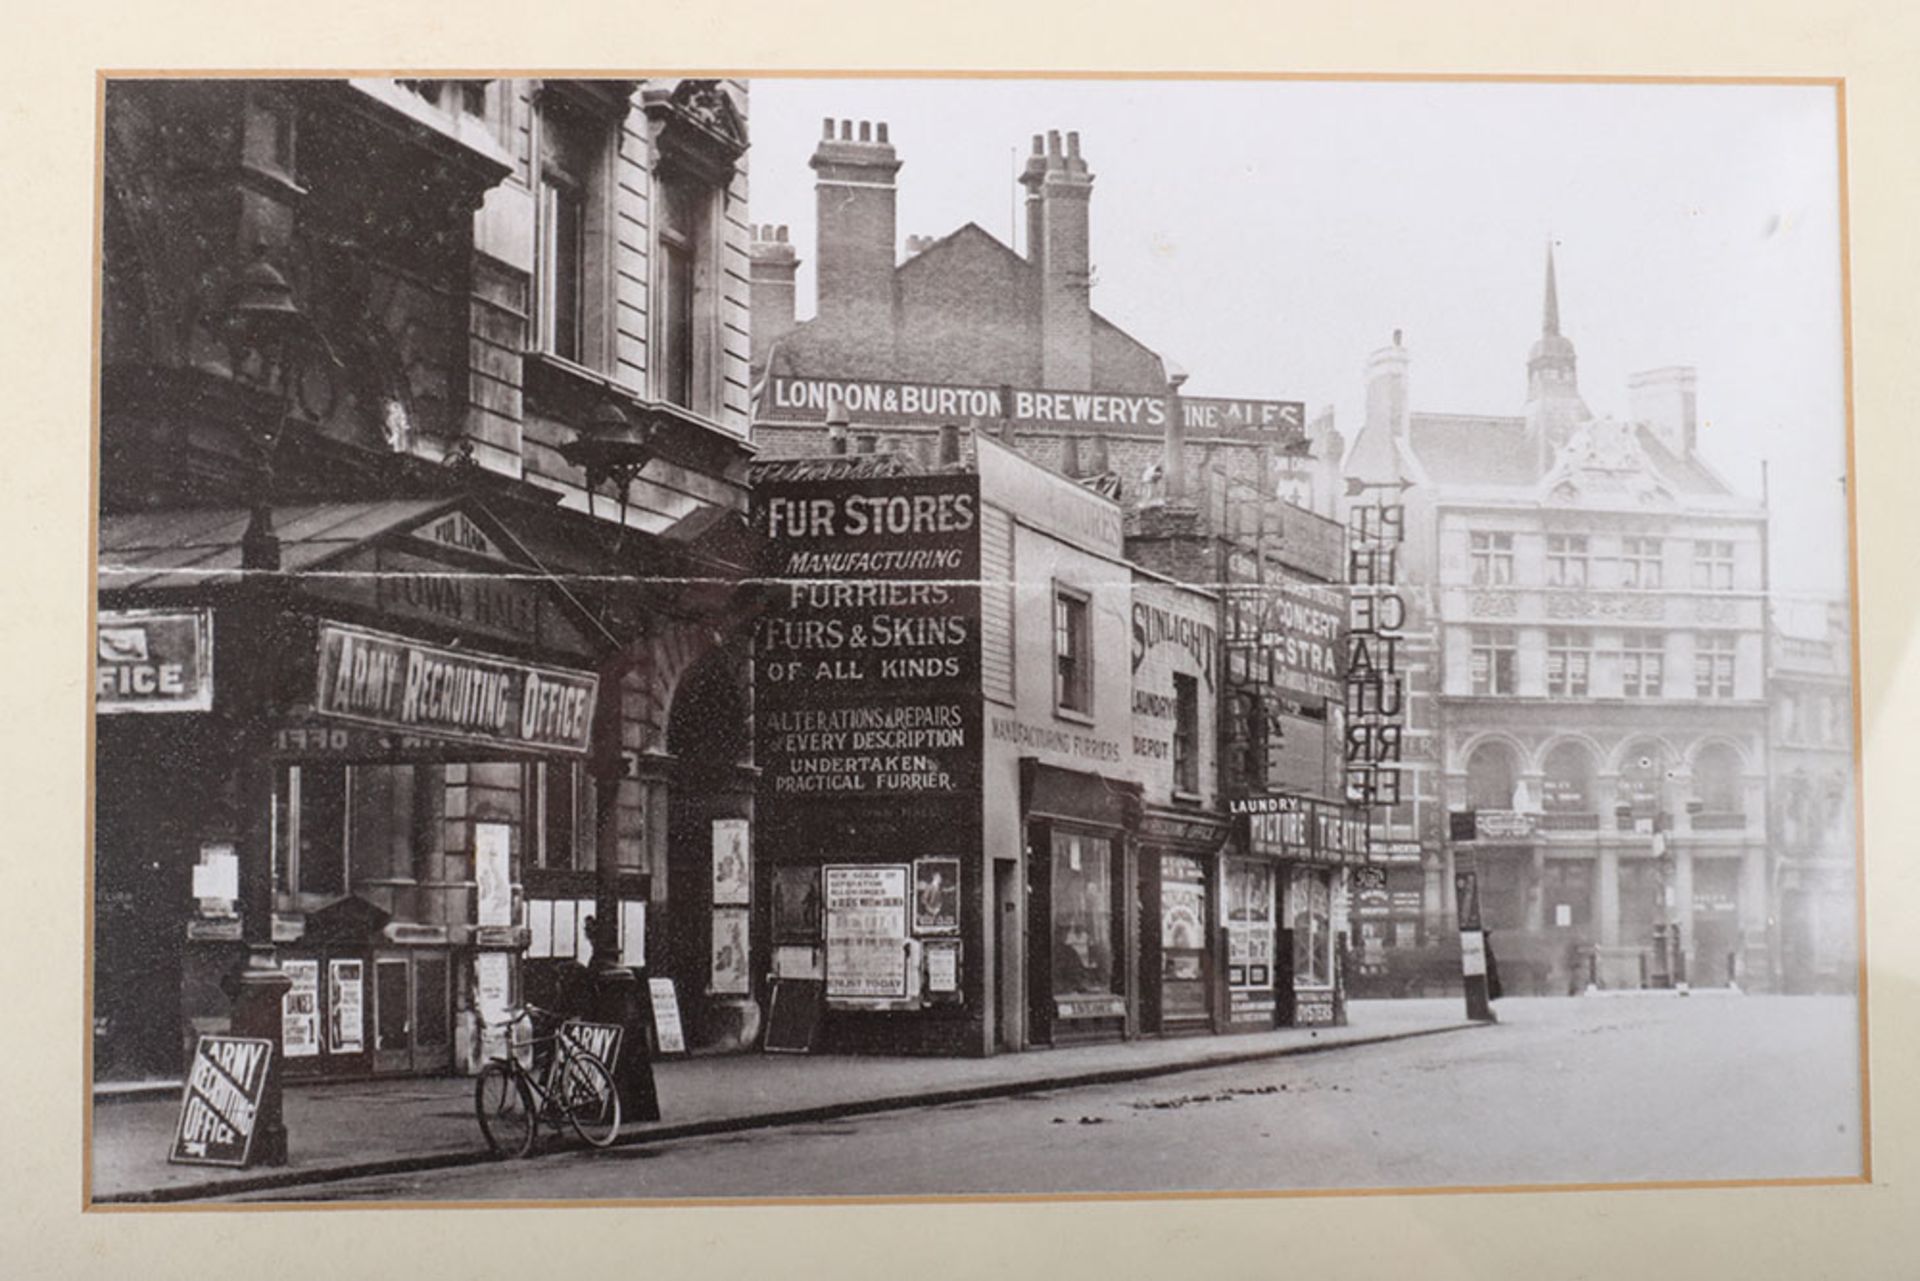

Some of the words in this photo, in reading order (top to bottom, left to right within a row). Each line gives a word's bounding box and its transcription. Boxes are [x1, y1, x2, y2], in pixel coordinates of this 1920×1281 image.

[1016, 391, 1165, 425] BREWERY'S
[1184, 405, 1218, 428] INE
[769, 498, 835, 538] FUR
[844, 494, 974, 535] STORES
[785, 549, 963, 574] MANUFACTURING
[766, 618, 844, 650] FURS
[849, 624, 868, 648] &
[872, 615, 967, 646] SKINS
[1131, 600, 1216, 694] SUNLIGHT
[768, 662, 802, 681] OF
[815, 661, 864, 680] ALL
[881, 657, 960, 679] KINDS
[332, 636, 398, 712] ARMY
[402, 650, 510, 729] RECRUITING
[522, 671, 587, 740] OFFICE
[786, 733, 847, 751] EVERY
[853, 729, 965, 750] DESCRIPTION
[1133, 735, 1168, 760] DEPOT
[790, 756, 927, 772] UNDERTAKEN
[776, 775, 864, 792] PRACTICAL
[876, 772, 956, 791] FURRIER.
[1230, 798, 1298, 813] LAUNDRY
[571, 1026, 617, 1063] ARMY
[209, 1042, 264, 1091] ARMY
[184, 1096, 235, 1144] OFFICE
